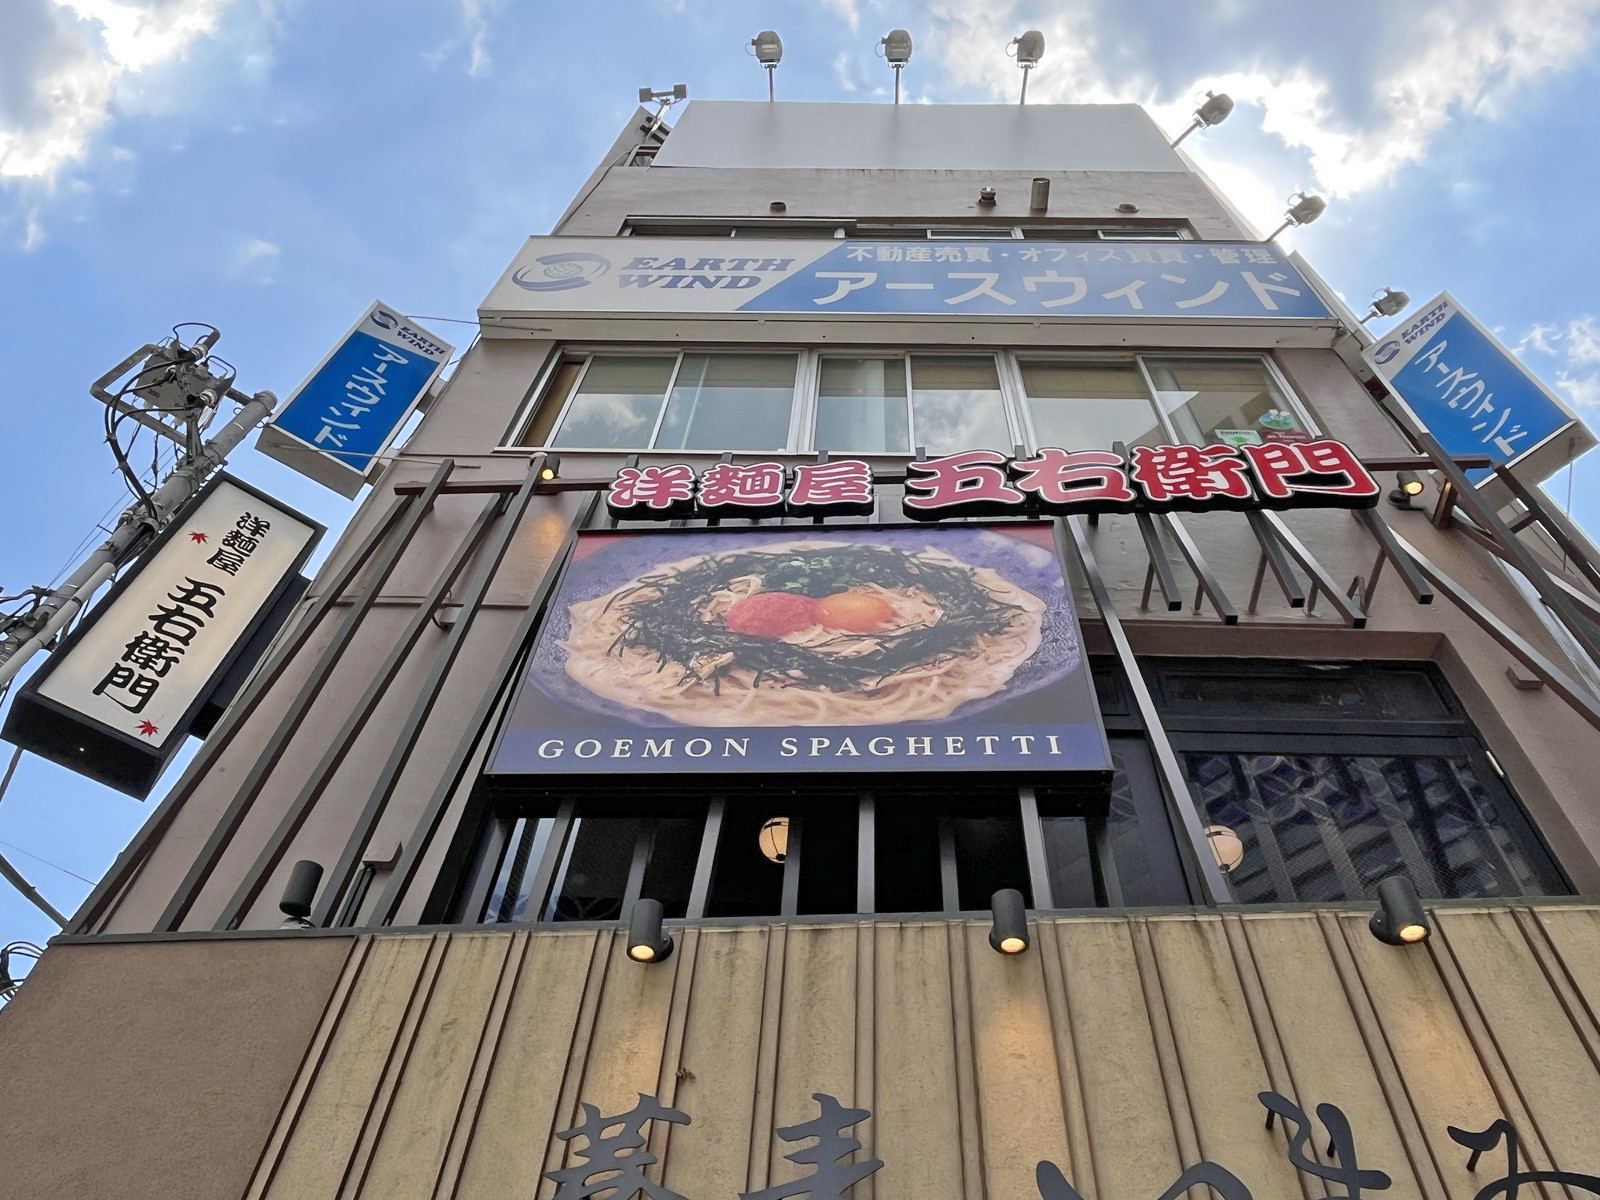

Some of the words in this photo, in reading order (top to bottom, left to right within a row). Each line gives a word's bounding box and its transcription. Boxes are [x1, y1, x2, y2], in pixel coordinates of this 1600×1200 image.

[620, 256, 796, 272] EARTH
[617, 274, 762, 290] WIND
[812, 268, 1302, 312] アースウィンド
[1400, 300, 1449, 338] EARTH
[1404, 312, 1447, 345] WIND
[396, 330, 435, 356] WIND
[398, 326, 446, 355] EARTH
[314, 343, 409, 448] アースウィンド
[1414, 339, 1528, 457] アースウィンド
[901, 438, 1381, 510] 五右衛門
[92, 575, 226, 714] 五右衛門
[537, 736, 751, 760] GOEMON
[780, 734, 1063, 758] SPAGHETTI
